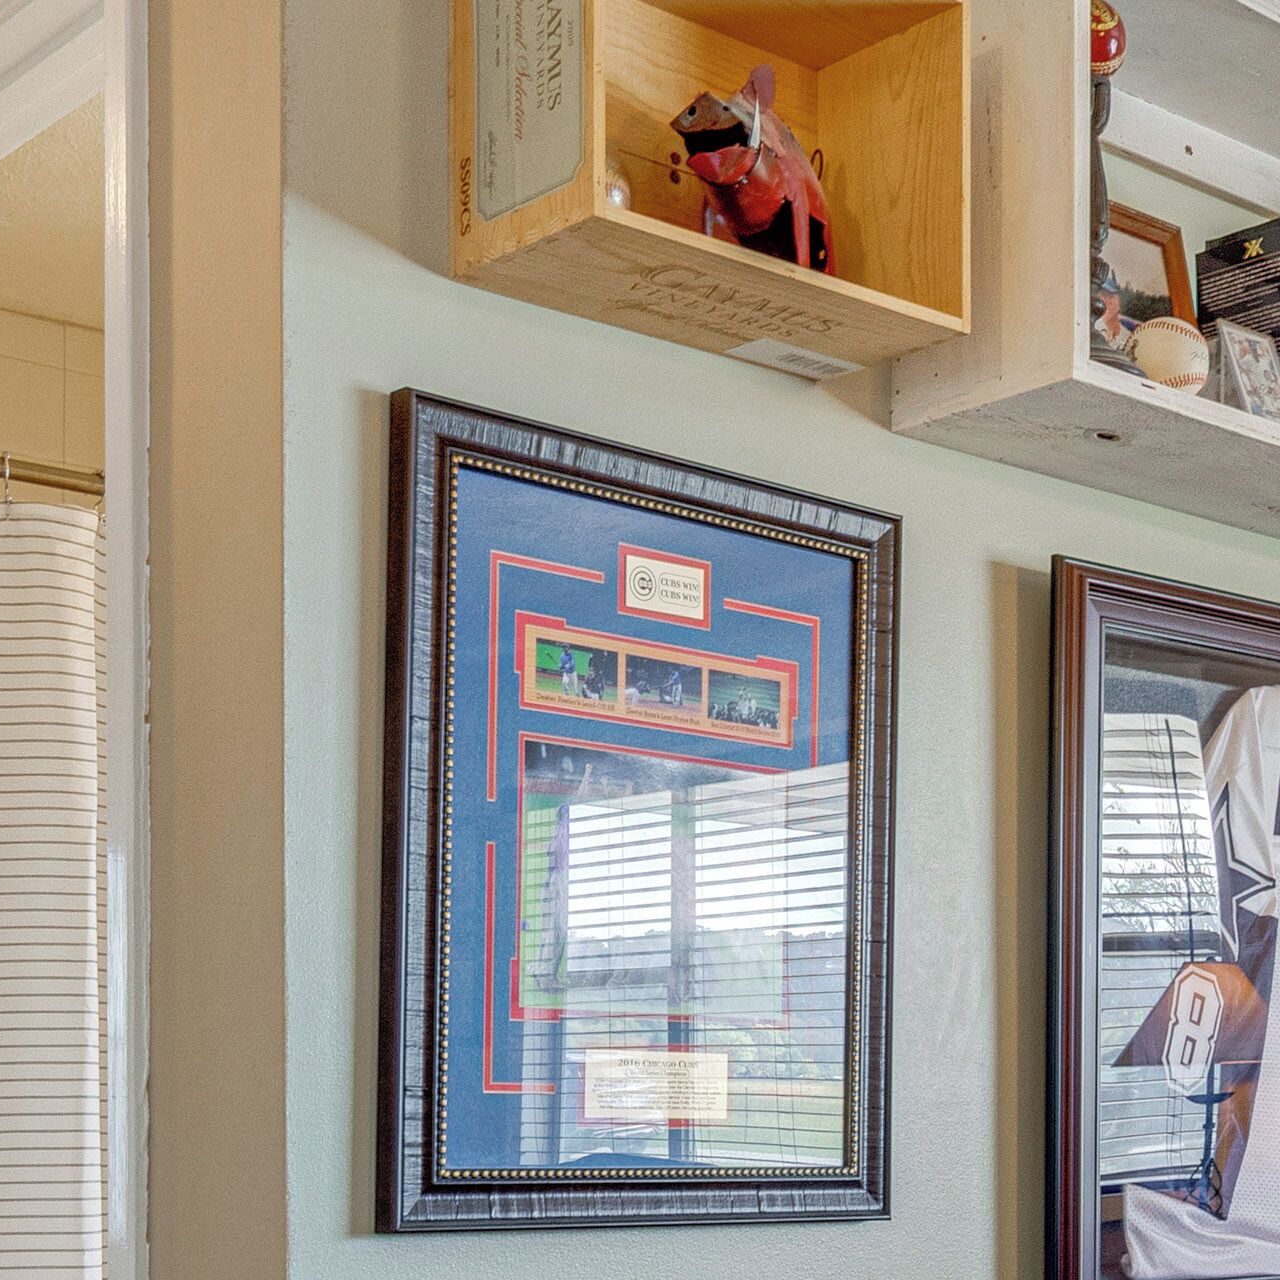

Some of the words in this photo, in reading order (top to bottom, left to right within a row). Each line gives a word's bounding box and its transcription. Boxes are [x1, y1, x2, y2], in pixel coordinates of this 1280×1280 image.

[547, 0, 562, 111] AYMUS
[515, 54, 532, 141] Selection
[460, 157, 472, 238] SS09CS
[640, 264, 845, 334] CAYMUS
[660, 577, 681, 590] CUBS
[682, 580, 701, 593] WIN!
[660, 588, 681, 601] CUBS
[618, 1058, 640, 1068] 2016
[642, 1059, 677, 1068] CHICAGO
[1162, 963, 1224, 1095] 8
